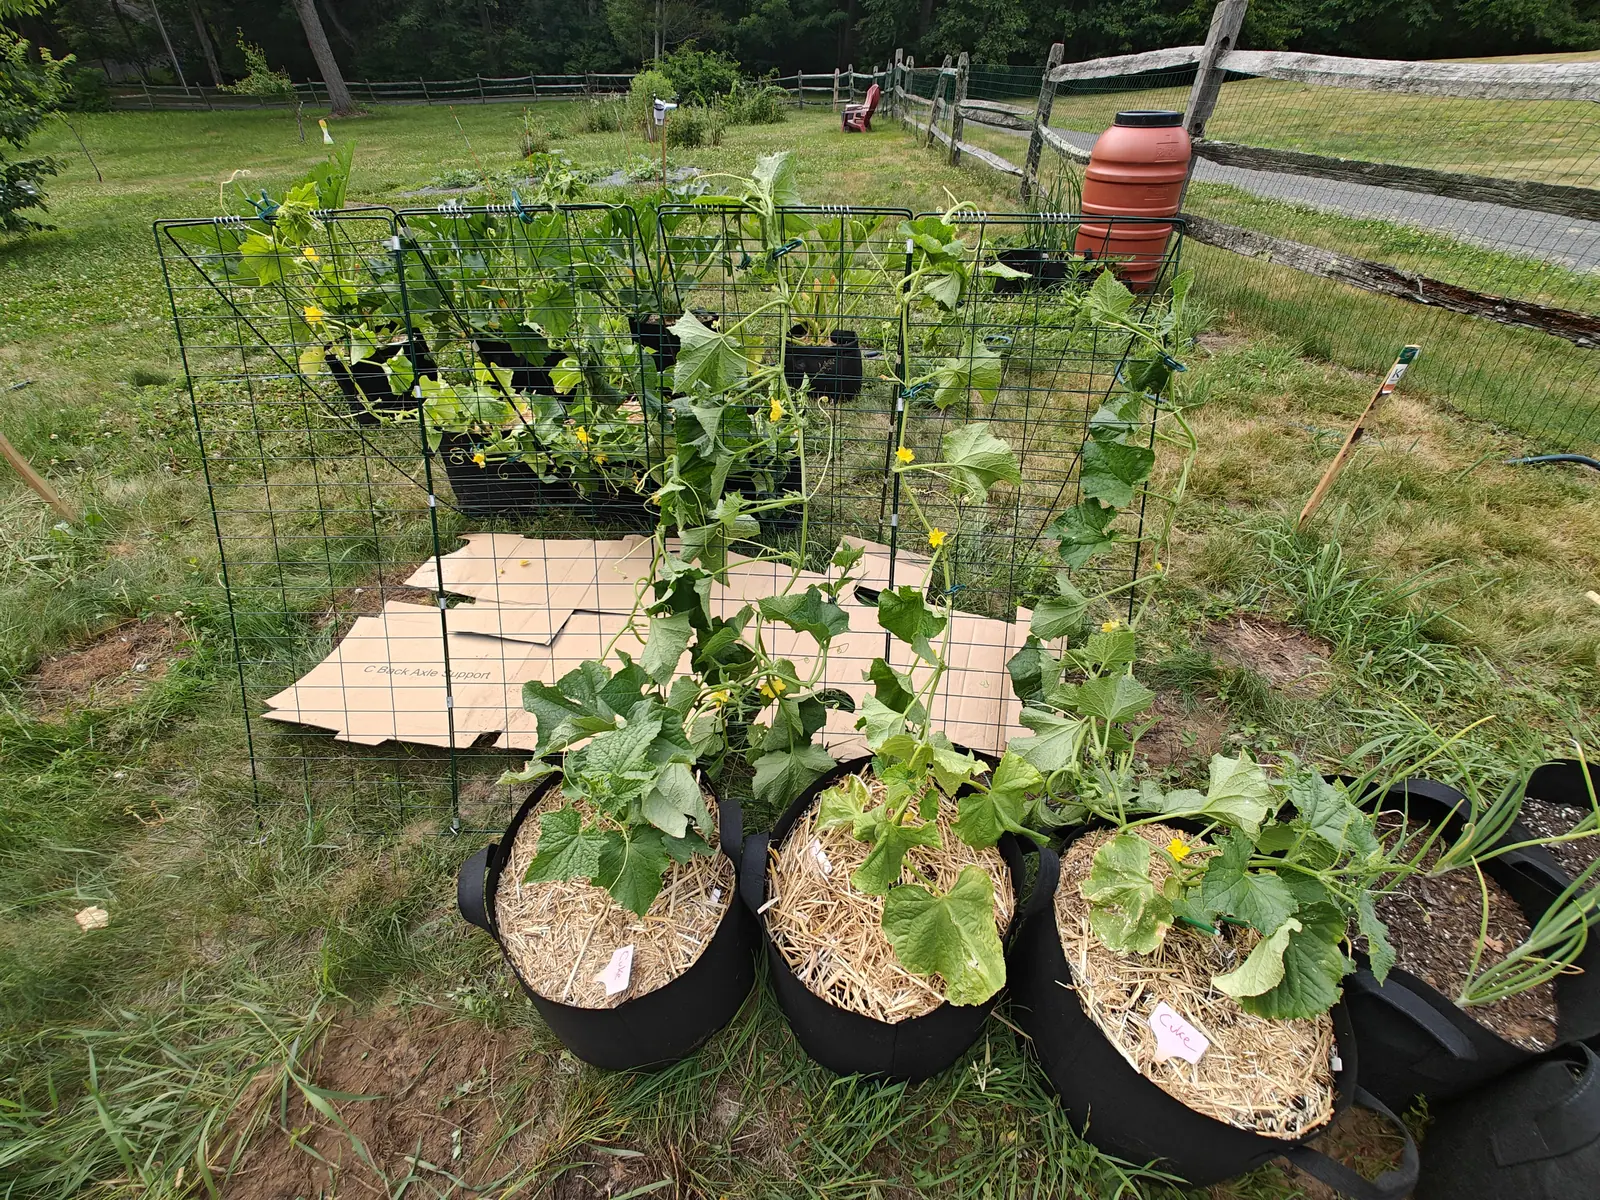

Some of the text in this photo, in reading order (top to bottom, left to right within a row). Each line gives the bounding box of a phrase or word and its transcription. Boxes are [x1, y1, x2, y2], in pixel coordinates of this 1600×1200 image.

[363, 665, 376, 673] C
[377, 666, 410, 676] Back
[409, 668, 439, 677] Axle
[1159, 1013, 1197, 1053] Cuke
